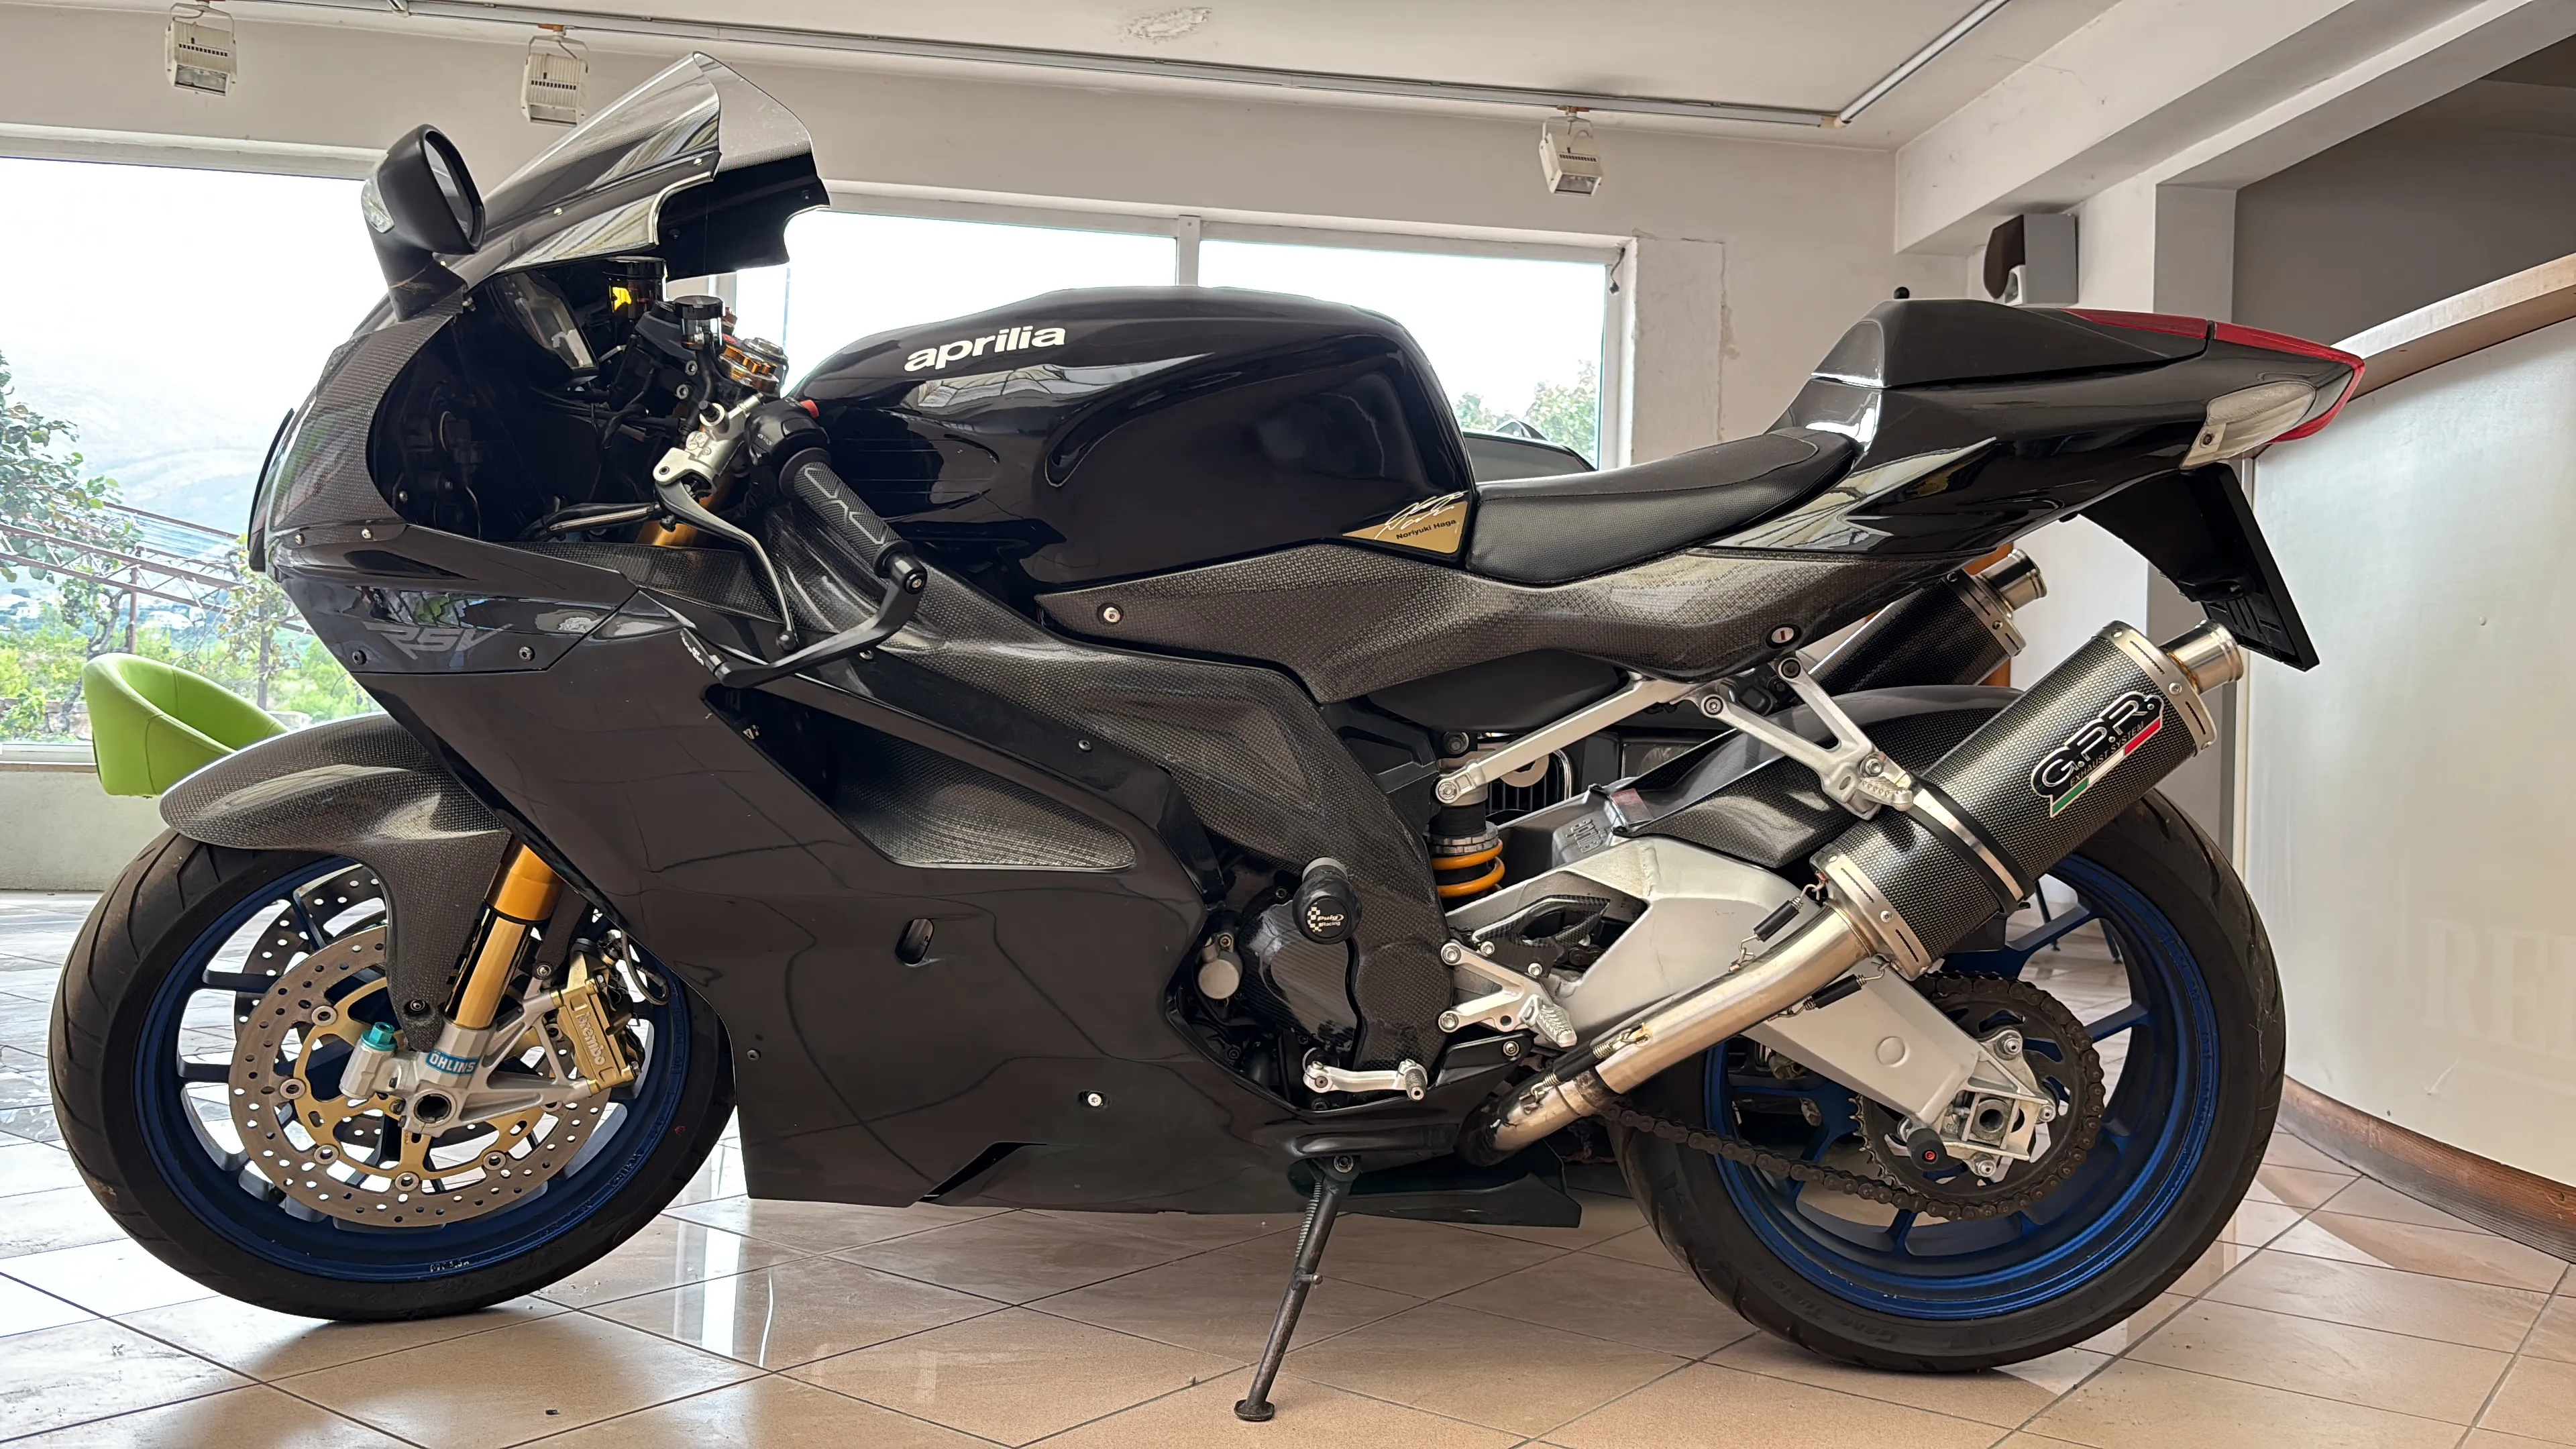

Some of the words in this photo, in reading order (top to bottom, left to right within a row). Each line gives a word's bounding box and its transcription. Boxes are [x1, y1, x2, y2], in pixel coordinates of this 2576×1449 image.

[904, 326, 1065, 372] aprilia
[1396, 525, 1432, 539] Noriyuki
[1434, 519, 1456, 530] Haga
[2070, 749, 2108, 787] EXHAUST
[2110, 720, 2145, 753] SYSTEM
[576, 1012, 605, 1065] brembo
[429, 1051, 475, 1073] ÖHLINS
